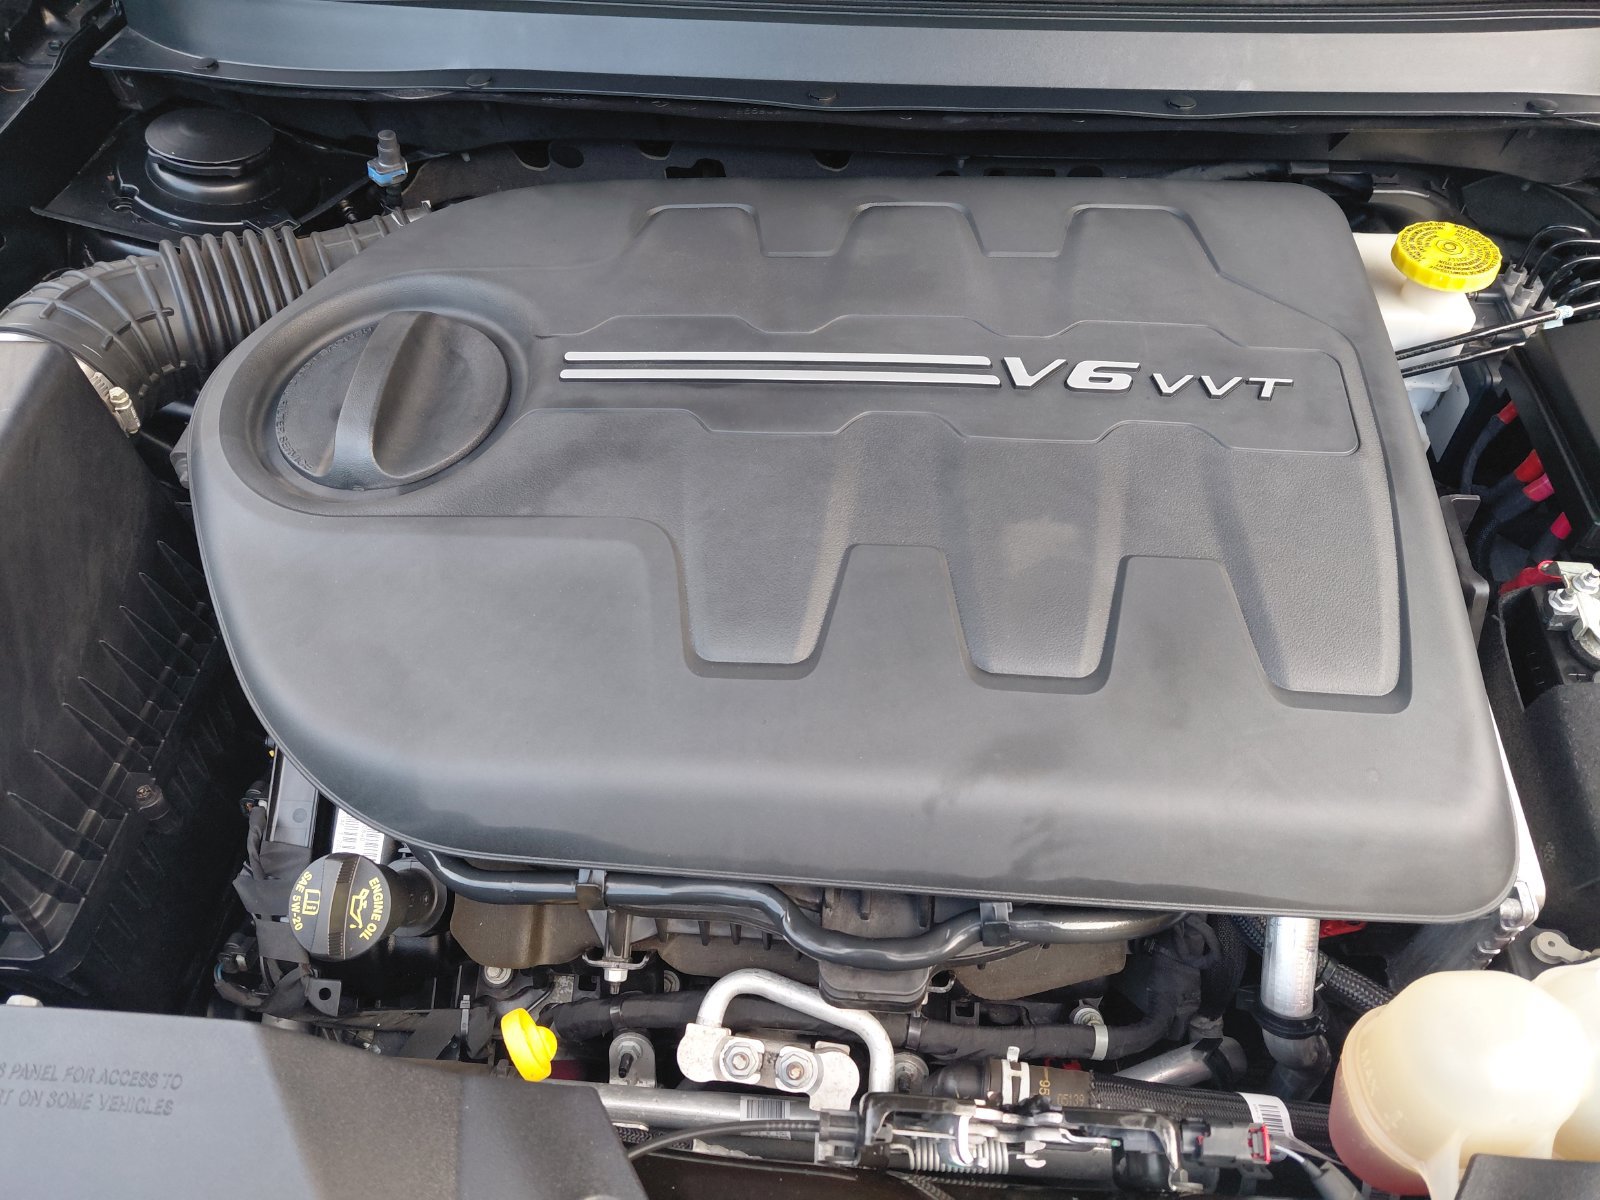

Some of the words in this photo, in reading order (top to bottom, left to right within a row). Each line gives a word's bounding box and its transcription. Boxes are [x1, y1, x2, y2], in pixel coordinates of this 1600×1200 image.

[1001, 355, 1142, 393] V6
[1150, 372, 1294, 401] VVT
[279, 435, 313, 471] SERVICE
[295, 871, 313, 893] SAE
[291, 894, 304, 931] 5W-20
[368, 877, 384, 922] ENGINE
[359, 922, 378, 940] OIL
[8, 1063, 58, 1082] PANEL
[63, 1066, 96, 1085] FOR
[97, 1068, 159, 1089] ACCESS
[162, 1072, 184, 1091] TO
[19, 1089, 44, 1108] ON
[46, 1090, 94, 1111] SOME
[99, 1093, 175, 1117] VEHICLES
